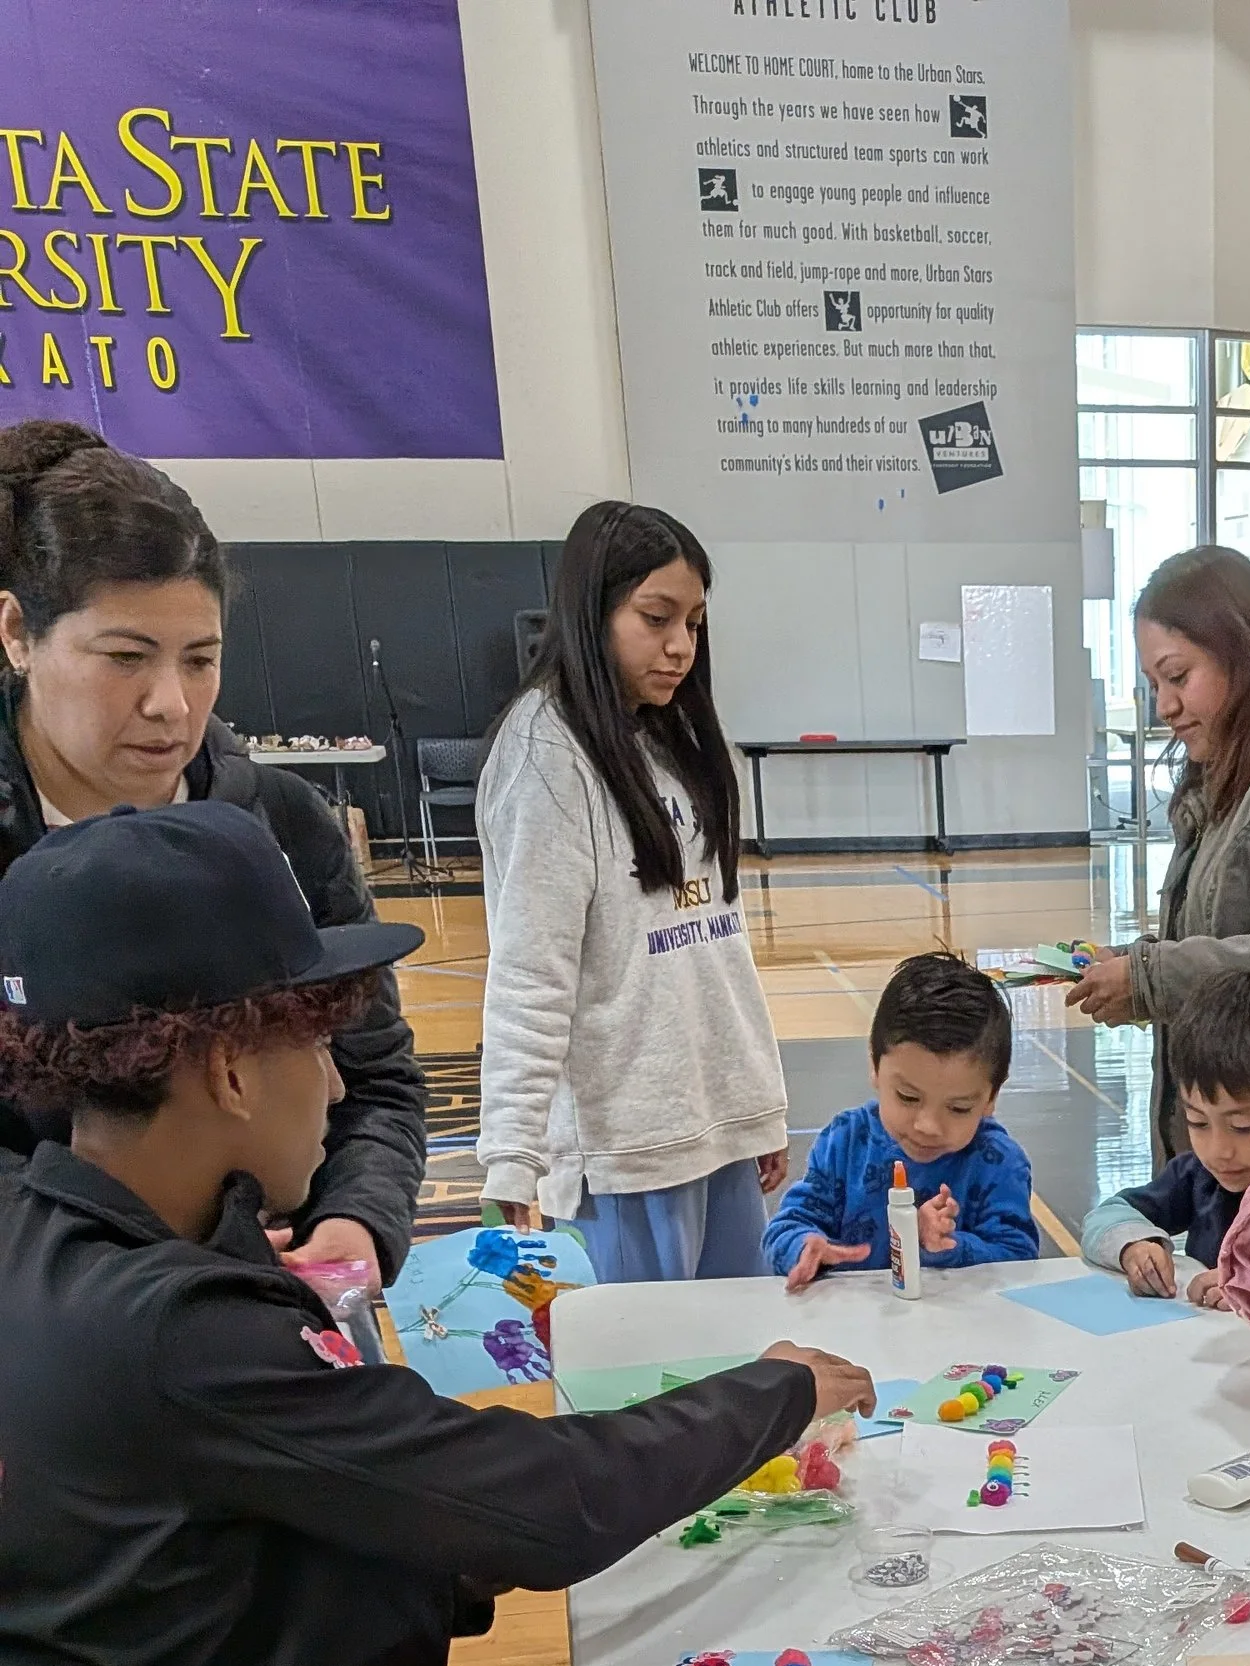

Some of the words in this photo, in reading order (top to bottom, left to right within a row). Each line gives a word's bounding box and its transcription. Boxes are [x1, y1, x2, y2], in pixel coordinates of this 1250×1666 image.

[875, 0, 937, 24] CLUB
[688, 52, 743, 75] WELCOME
[744, 55, 760, 75] TO
[763, 56, 795, 77] HOME
[798, 57, 839, 81] COURT,
[841, 59, 874, 80] home
[877, 64, 890, 81] to
[893, 61, 914, 82] the
[917, 62, 952, 84] Urban
[955, 64, 986, 85] Stars.
[692, 94, 748, 121] Through
[752, 96, 774, 117] the
[778, 103, 815, 123] years
[819, 105, 838, 120] we
[842, 100, 874, 121] have
[878, 107, 910, 122] seen
[914, 103, 941, 124] how
[696, 139, 751, 158] athletics
[756, 141, 780, 159] and
[785, 142, 849, 161] structured
[853, 145, 884, 162] team
[889, 147, 928, 168] sports
[933, 150, 956, 165] can
[960, 146, 989, 166] work
[751, 183, 764, 199] to
[769, 185, 815, 205] engage
[819, 186, 857, 206] young
[861, 183, 903, 207] people
[907, 184, 930, 204] and
[934, 185, 990, 205] influence
[702, 220, 734, 238] them
[738, 221, 757, 239] for
[762, 222, 797, 240] much
[802, 223, 838, 245] good.
[841, 223, 868, 241] With
[946, 230, 992, 246] soccer,
[704, 261, 738, 278] track
[740, 262, 763, 279] and
[766, 262, 798, 280] field,
[799, 262, 861, 285] jump-rope
[864, 264, 887, 281] and
[890, 268, 923, 284] more,
[925, 264, 960, 283] Urban
[963, 265, 993, 284] Stars
[708, 299, 753, 318] Athletic
[756, 299, 782, 318] Club
[785, 300, 820, 318] offers
[866, 303, 932, 324] opportunity
[935, 303, 952, 320] for
[956, 303, 995, 325] quality
[711, 338, 759, 357] athletic
[763, 339, 839, 361] experiences.
[843, 338, 864, 357] But
[867, 339, 900, 358] much
[904, 344, 933, 358] more
[937, 340, 965, 358] than
[713, 377, 724, 395] it
[729, 376, 783, 400] provides
[787, 376, 808, 395] life
[813, 377, 846, 396] skills
[851, 377, 901, 401] learning
[906, 378, 929, 397] and
[934, 377, 998, 403] leadership
[717, 417, 764, 438] training
[766, 418, 779, 434] to
[782, 420, 814, 439] many
[816, 416, 871, 434] hundreds
[874, 416, 886, 434] of
[888, 421, 908, 434] our
[720, 454, 792, 476] community's
[794, 454, 819, 472] kids
[821, 454, 844, 472] and
[845, 453, 874, 472] their
[875, 455, 921, 472] visitors.
[672, 877, 712, 911] MSU
